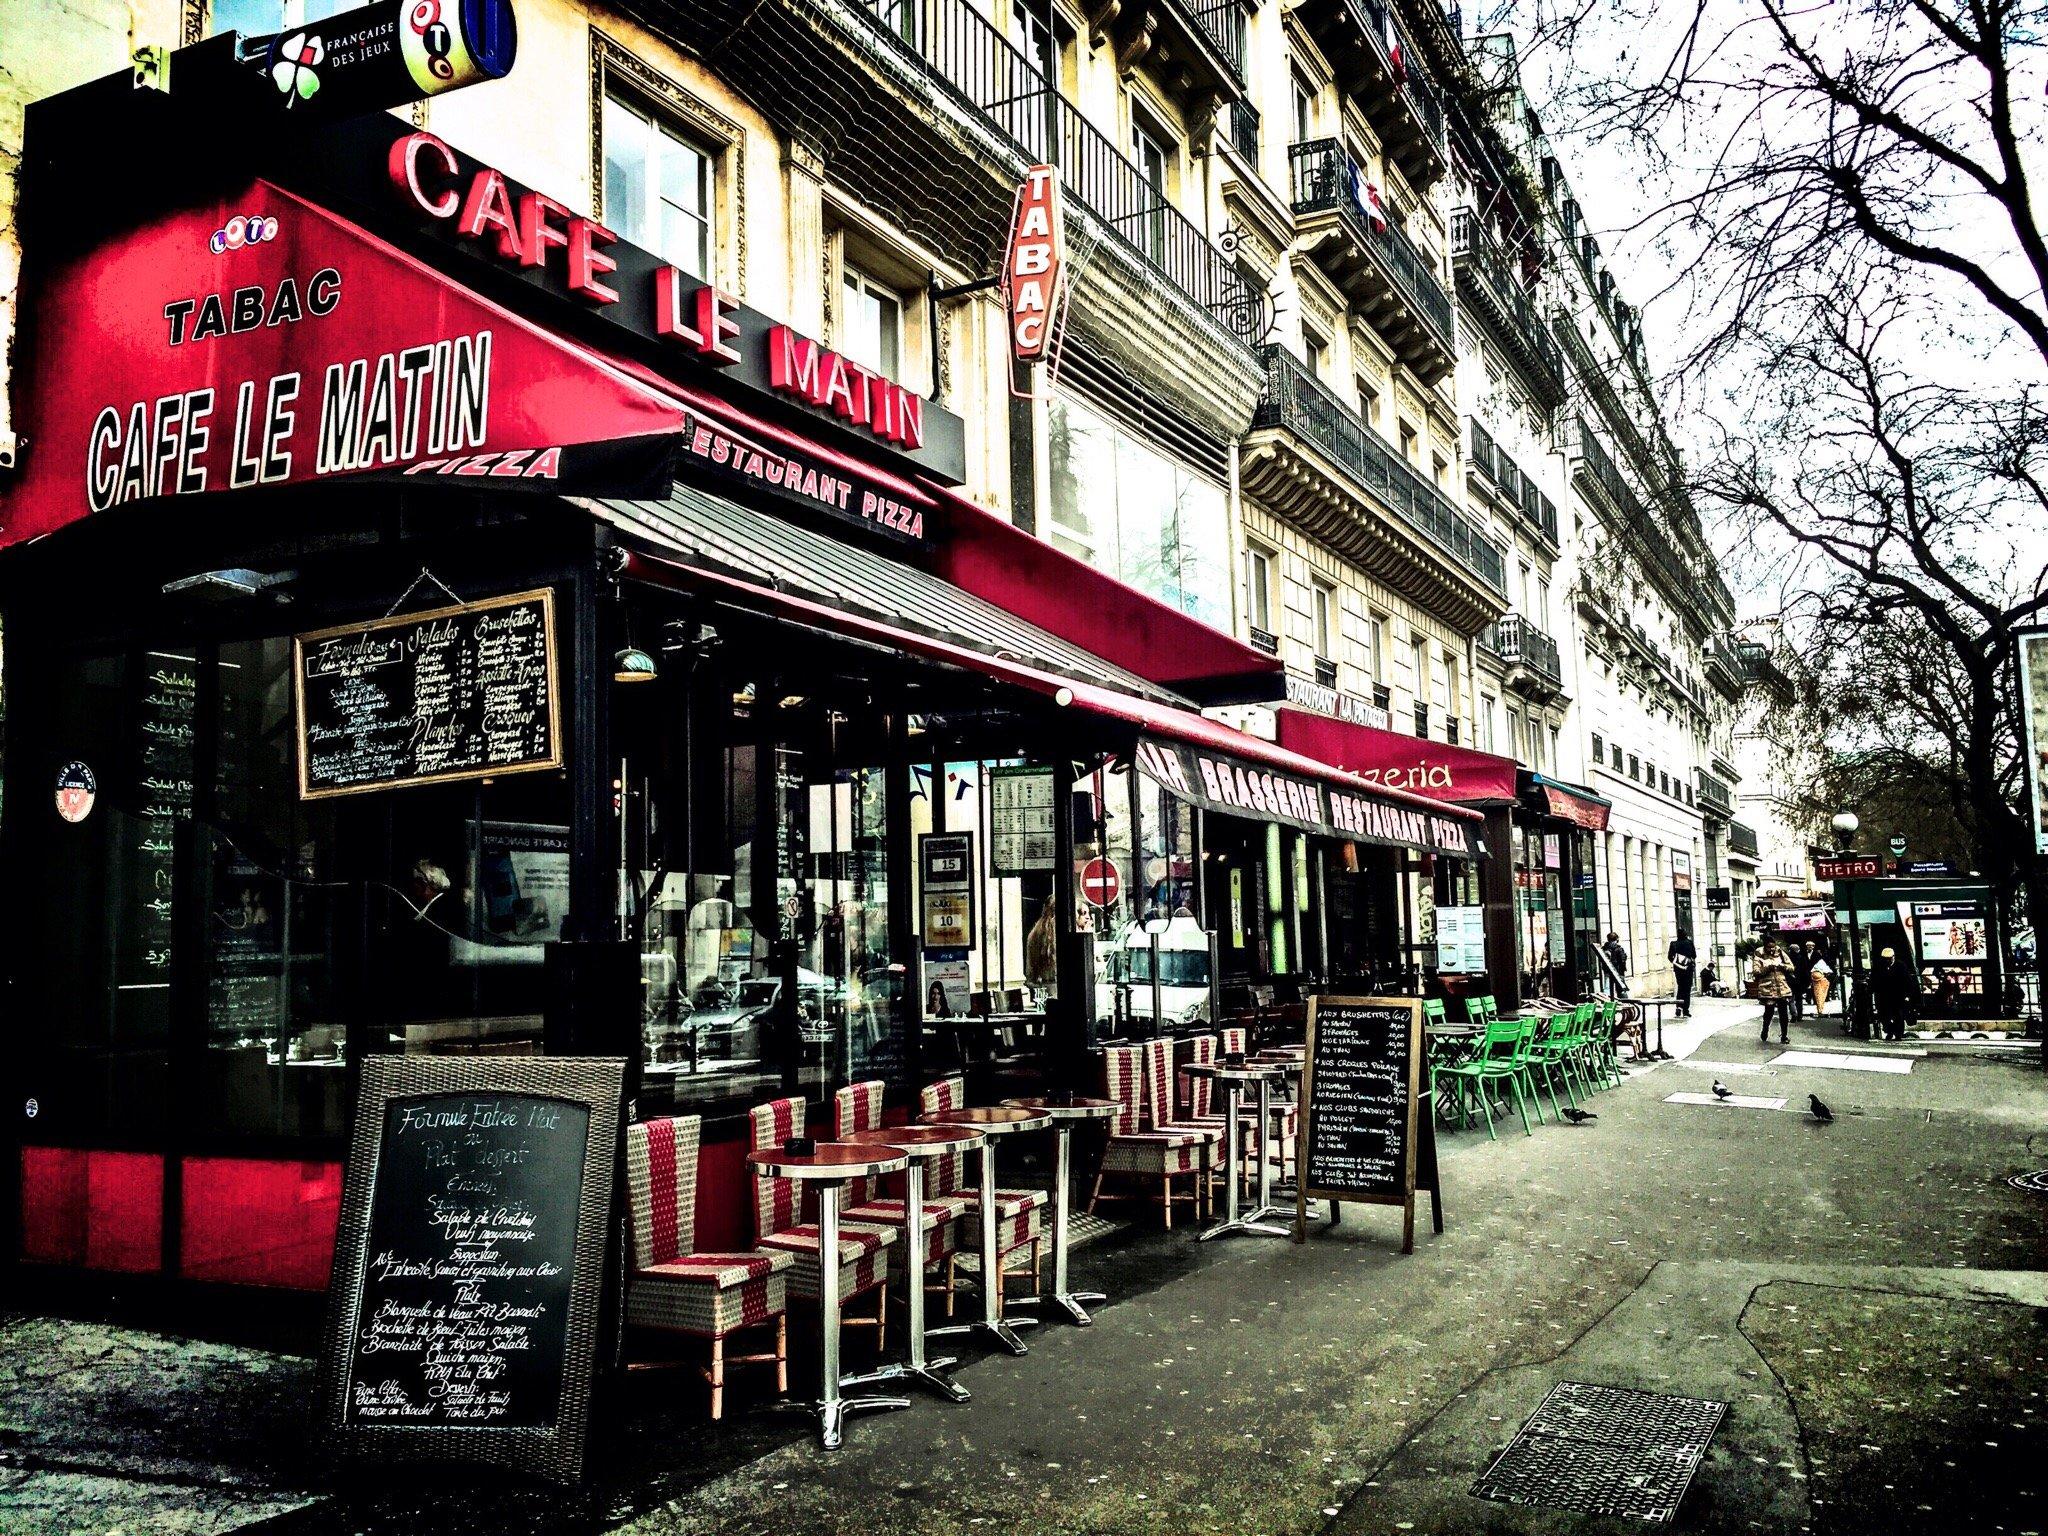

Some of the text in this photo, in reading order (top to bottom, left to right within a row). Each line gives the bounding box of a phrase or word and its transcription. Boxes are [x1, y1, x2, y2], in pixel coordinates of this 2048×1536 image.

[327, 22, 395, 51] FRANÇAISE
[332, 41, 391, 68] DES JEUX
[210, 215, 279, 254] LOTO
[1016, 169, 1050, 350] TABAC
[164, 267, 342, 346] TABAC
[388, 130, 924, 451] CAFE LE MATIN
[87, 329, 493, 513] CAFE LE MATIN
[403, 448, 562, 478] PIZZA
[682, 426, 923, 539] ESTAURANT PIZZA
[1199, 757, 1323, 824] BRASSERIE
[1329, 792, 1429, 846] RESTAURANT
[1432, 816, 1469, 852] PIZZA
[1890, 837, 1906, 846] BUS
[942, 859, 956, 870] 15
[940, 916, 953, 927] 10
